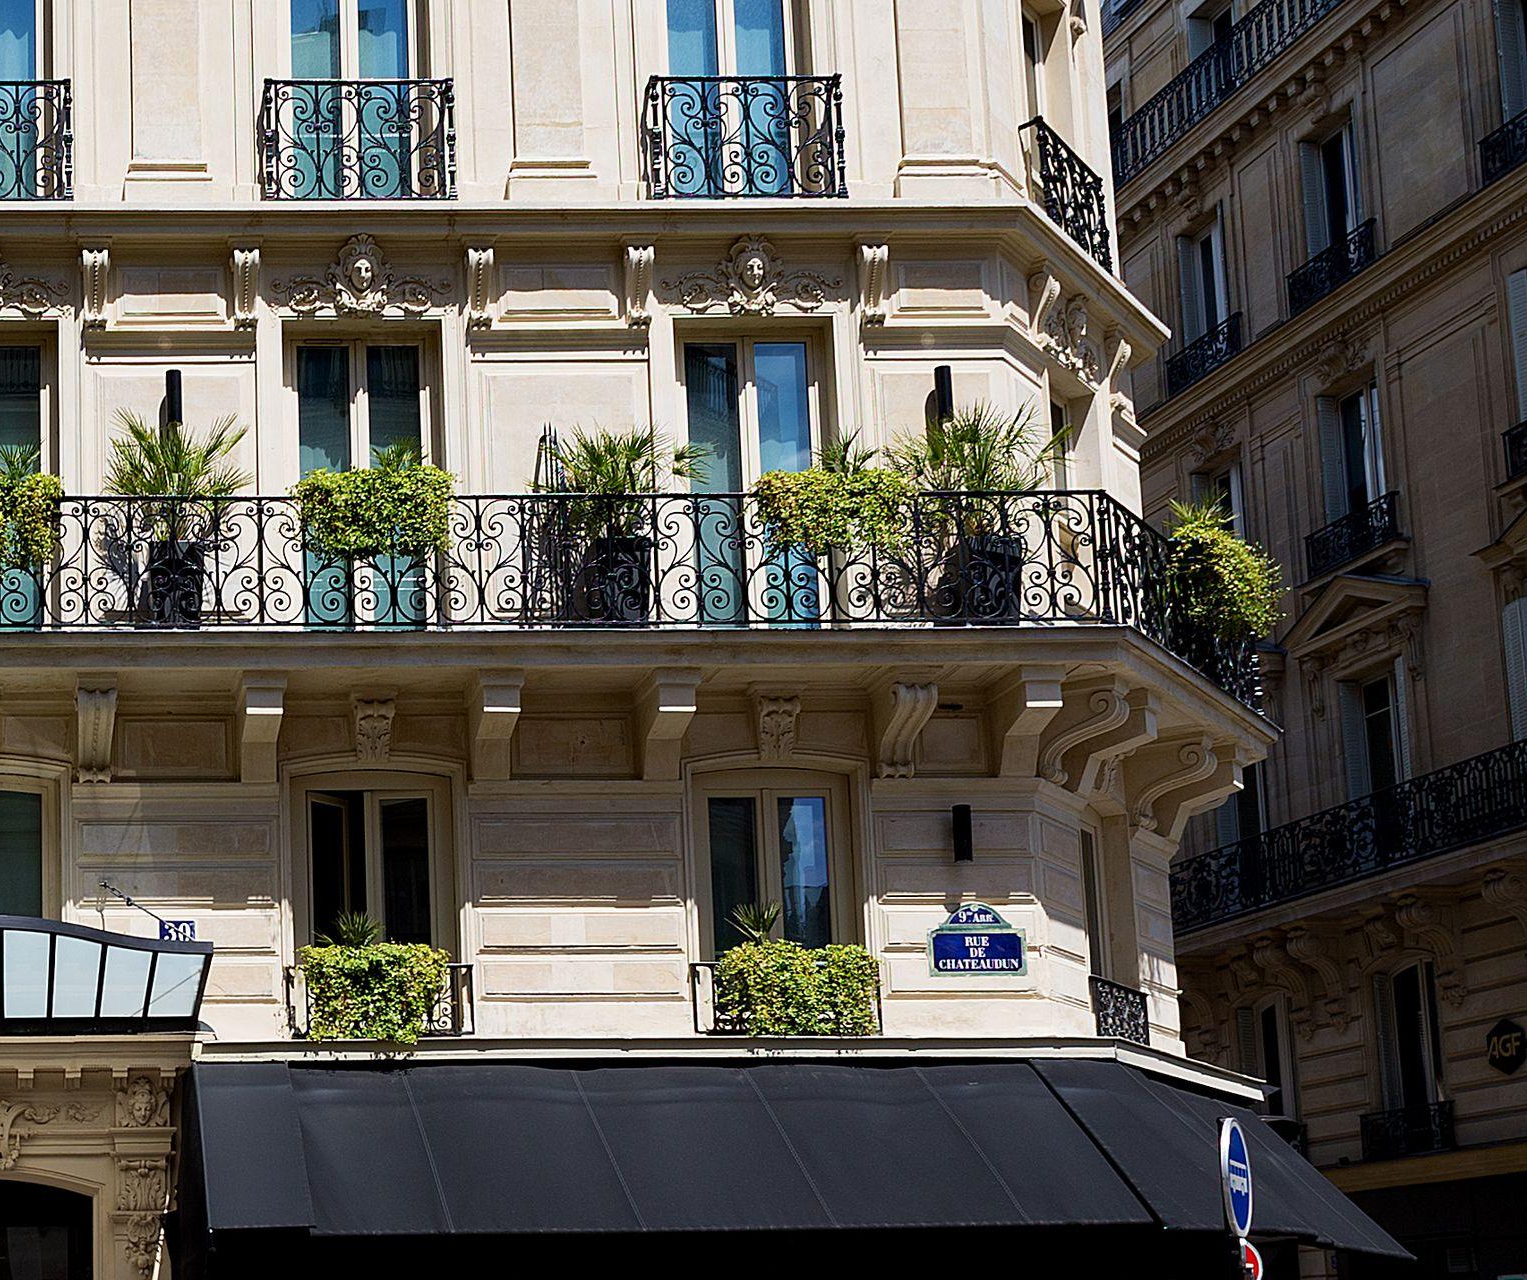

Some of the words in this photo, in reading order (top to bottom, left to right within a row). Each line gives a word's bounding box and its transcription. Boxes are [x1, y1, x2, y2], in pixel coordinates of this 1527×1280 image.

[164, 922, 191, 941] 30
[964, 936, 990, 947] RUE
[969, 947, 986, 957] DE
[938, 959, 1019, 969] CHATEAUDUN
[1488, 1032, 1522, 1060] AGF
